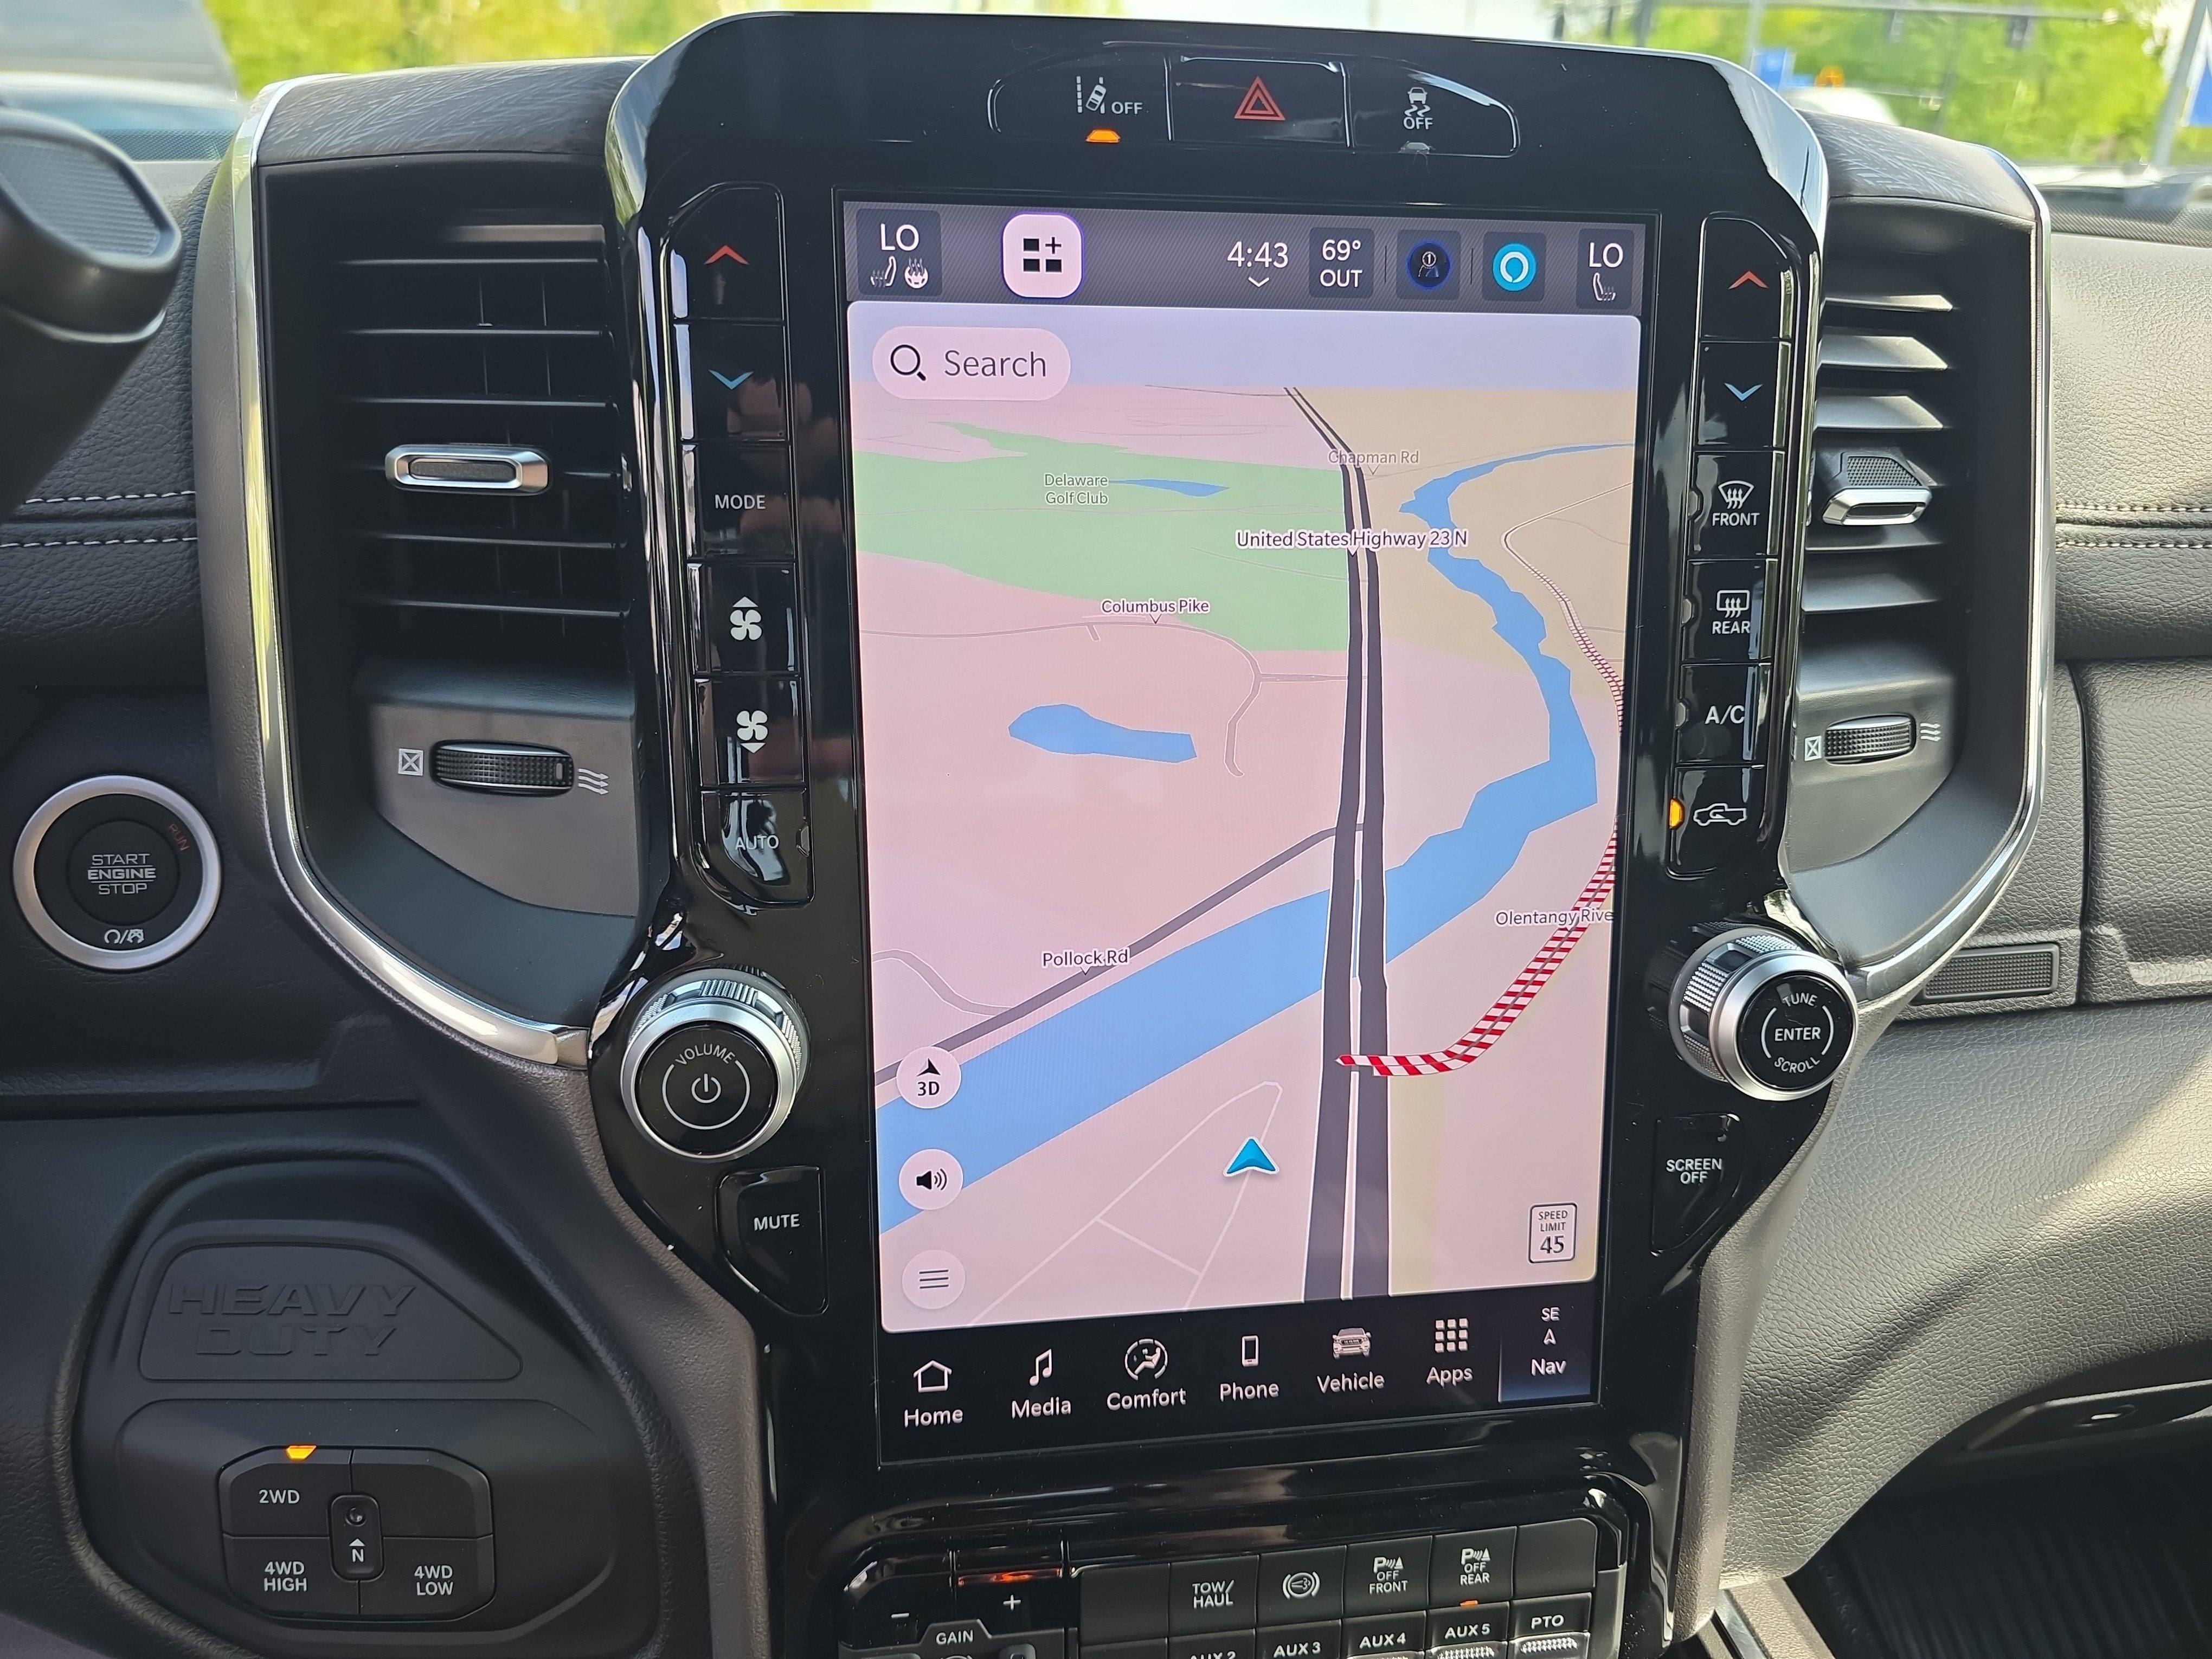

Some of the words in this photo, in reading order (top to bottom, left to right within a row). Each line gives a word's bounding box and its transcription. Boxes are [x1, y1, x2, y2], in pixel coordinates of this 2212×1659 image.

[1110, 100, 1143, 115] OFF
[1403, 116, 1433, 130] OFF
[880, 223, 919, 251] LO
[1227, 241, 1289, 269] 4:43
[1322, 239, 1361, 262] 69°
[1589, 242, 1623, 269] LO
[1320, 269, 1362, 289] OUT
[943, 349, 1047, 378] Search
[1328, 451, 1397, 467] Chapman
[1400, 451, 1419, 464] Rd
[1044, 474, 1109, 487] Delaware
[715, 494, 766, 510] MODE
[1045, 492, 1075, 504] Golf
[1077, 492, 1109, 504] Club
[1712, 512, 1759, 527] FRONT
[1237, 532, 1293, 548] United
[1297, 532, 1349, 548] States
[1354, 531, 1426, 549] Highway
[1430, 531, 1450, 548] 23
[1456, 531, 1467, 546] N
[1102, 599, 1176, 614] Columbus
[1179, 599, 1209, 613] Pike
[1712, 622, 1750, 634] REAR
[1705, 705, 1745, 725] A/C
[168, 823, 190, 851] RUN
[735, 835, 779, 851] AUTO
[92, 854, 150, 865] START
[88, 869, 156, 879] ENGINE
[99, 883, 147, 895] STOP
[1496, 910, 1577, 926] Olentangy
[1043, 951, 1101, 967] Pollock
[1105, 950, 1128, 964] Rd
[1782, 993, 1818, 1007] TUNE
[1774, 1027, 1821, 1041] ENTER
[676, 1045, 736, 1066] VOLUME
[1774, 1056, 1821, 1073] SCROLL
[917, 1081, 940, 1096] 3D
[1666, 1159, 1722, 1172] SCREEN
[1680, 1171, 1707, 1184] OFF
[754, 1214, 800, 1231] MUTE
[1538, 1210, 1568, 1220] SPEED
[1540, 1222, 1566, 1232] LIMIT
[1540, 1236, 1564, 1254] 45
[169, 1283, 417, 1316] HEAVY
[1541, 1307, 1560, 1321] SE
[196, 1324, 397, 1356] DUTY
[1531, 1359, 1566, 1376] Nav
[1317, 1371, 1385, 1393] Vehicle
[1426, 1365, 1473, 1387] Apps
[1107, 1388, 1186, 1410] Comfort
[1219, 1381, 1279, 1402] Phone
[1012, 1397, 1071, 1419] Media
[904, 1408, 963, 1427] Home
[259, 1489, 300, 1504] 2WD
[351, 1549, 365, 1563] N
[265, 1562, 305, 1576] 4WD
[414, 1565, 453, 1580] 4WD
[1377, 1570, 1399, 1581] OFF
[1464, 1562, 1487, 1573] OFF
[263, 1577, 307, 1592] HIGH
[1192, 1579, 1234, 1595] TOW/
[1369, 1580, 1409, 1594] FRONT
[1460, 1572, 1490, 1586] REAR
[416, 1581, 454, 1596] LOW
[1193, 1592, 1234, 1608] HAUL
[1531, 1615, 1564, 1629] PTO
[936, 1630, 974, 1645] GAIN
[1444, 1625, 1479, 1639] AUX
[1482, 1623, 1490, 1636] 5
[1359, 1634, 1394, 1649] AUX
[1397, 1632, 1406, 1645] 4
[1274, 1642, 1309, 1658] AUX
[1312, 1641, 1321, 1654] 3
